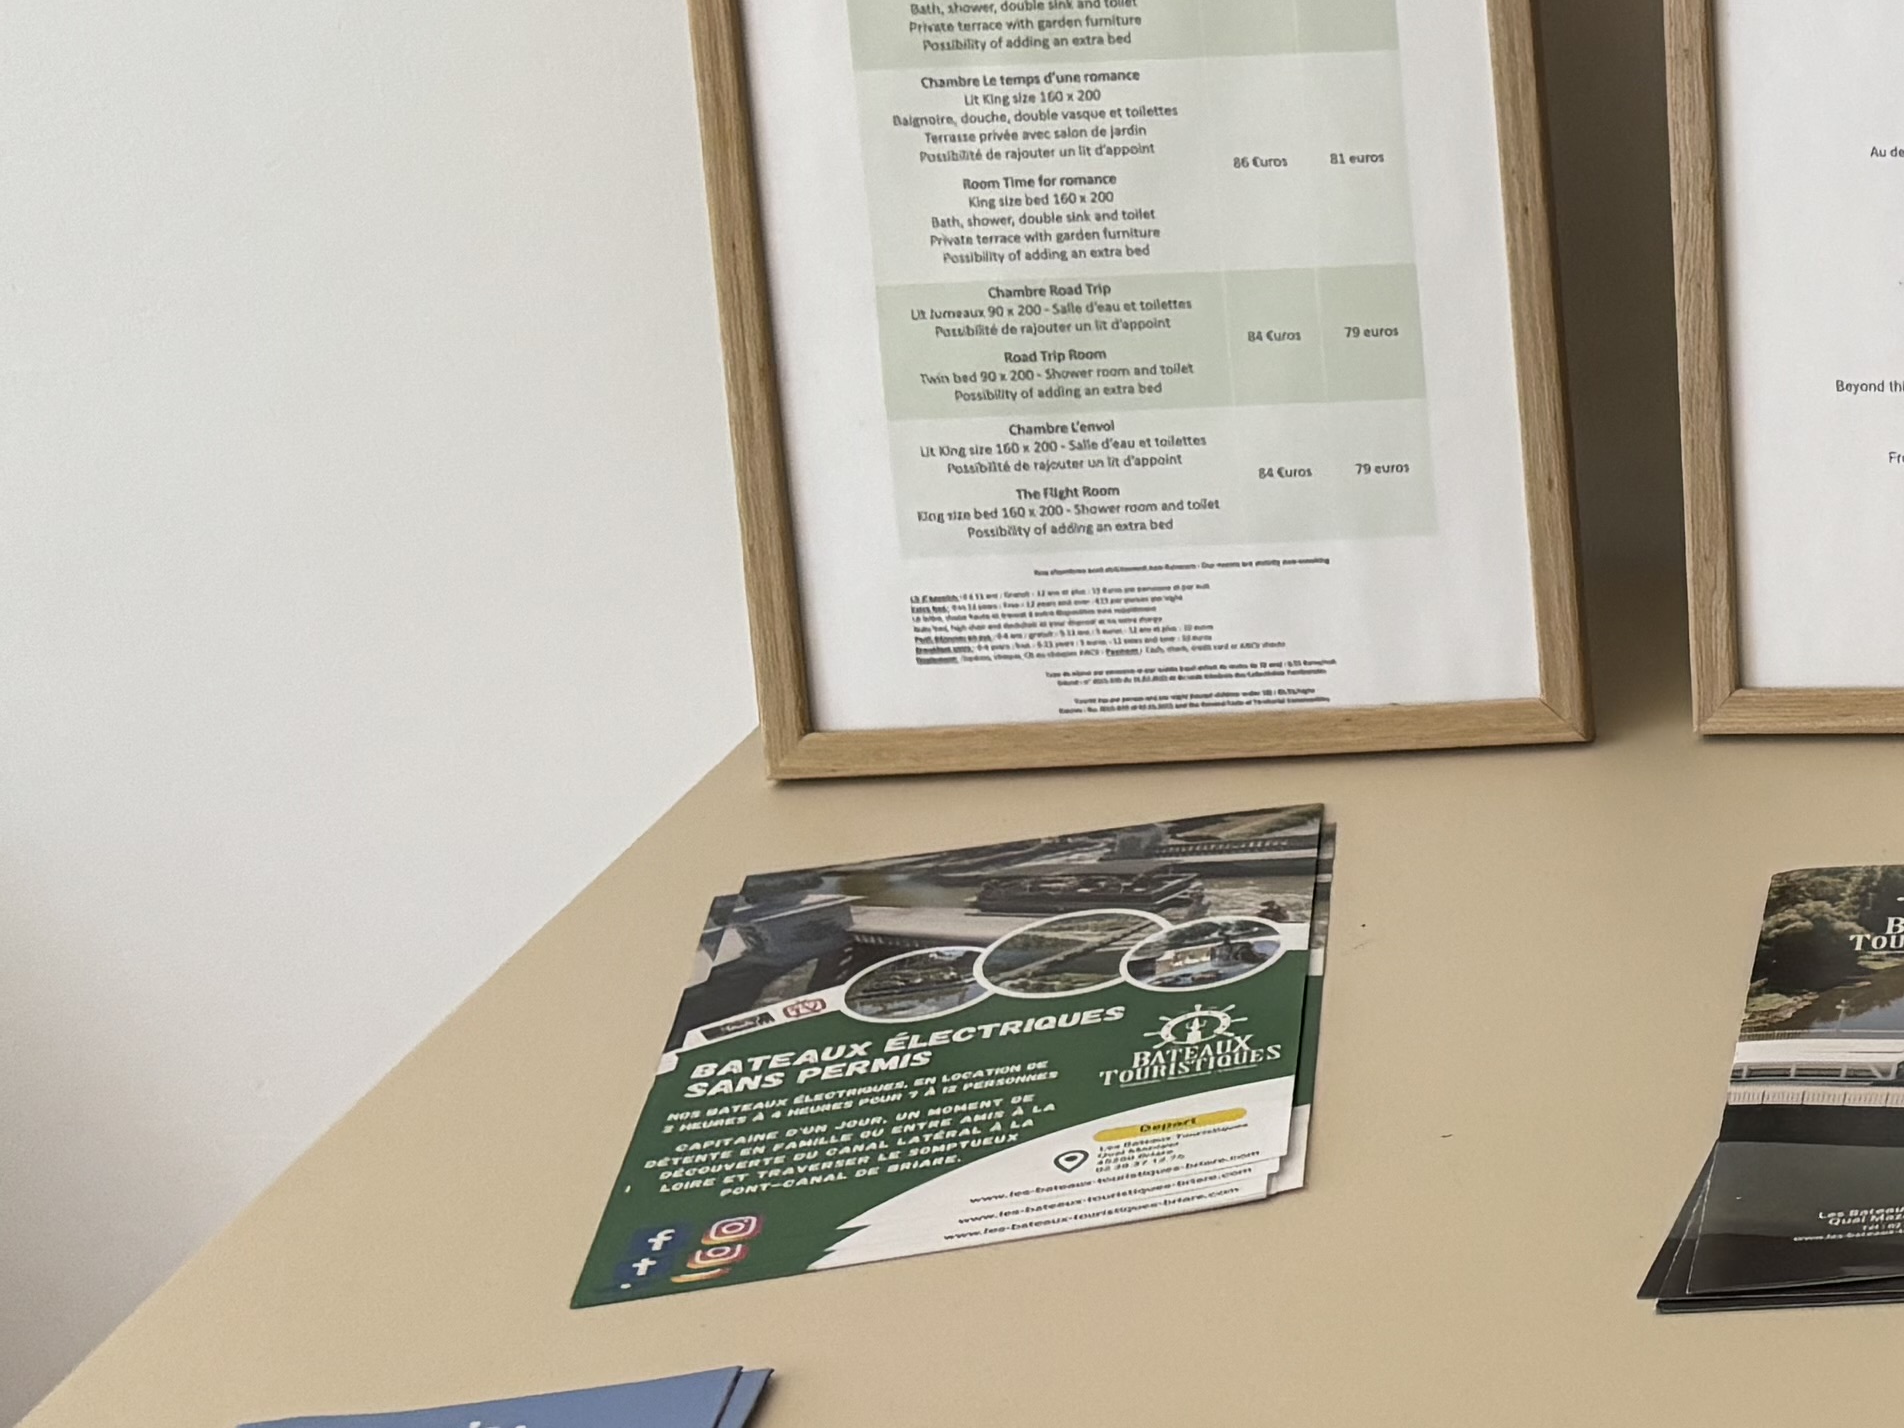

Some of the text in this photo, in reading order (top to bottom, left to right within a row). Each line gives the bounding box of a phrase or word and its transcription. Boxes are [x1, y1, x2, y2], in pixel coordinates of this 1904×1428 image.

[690, 1004, 1127, 1079] BATEAUX ÉLECTRIQUES
[1132, 1034, 1254, 1069] BATEAUX
[684, 1050, 933, 1098] SANS PERMIS
[1099, 1043, 1282, 1086] TOURISTIQUES
[719, 1155, 962, 1197] PONT-CANAL DE BRIARE.
